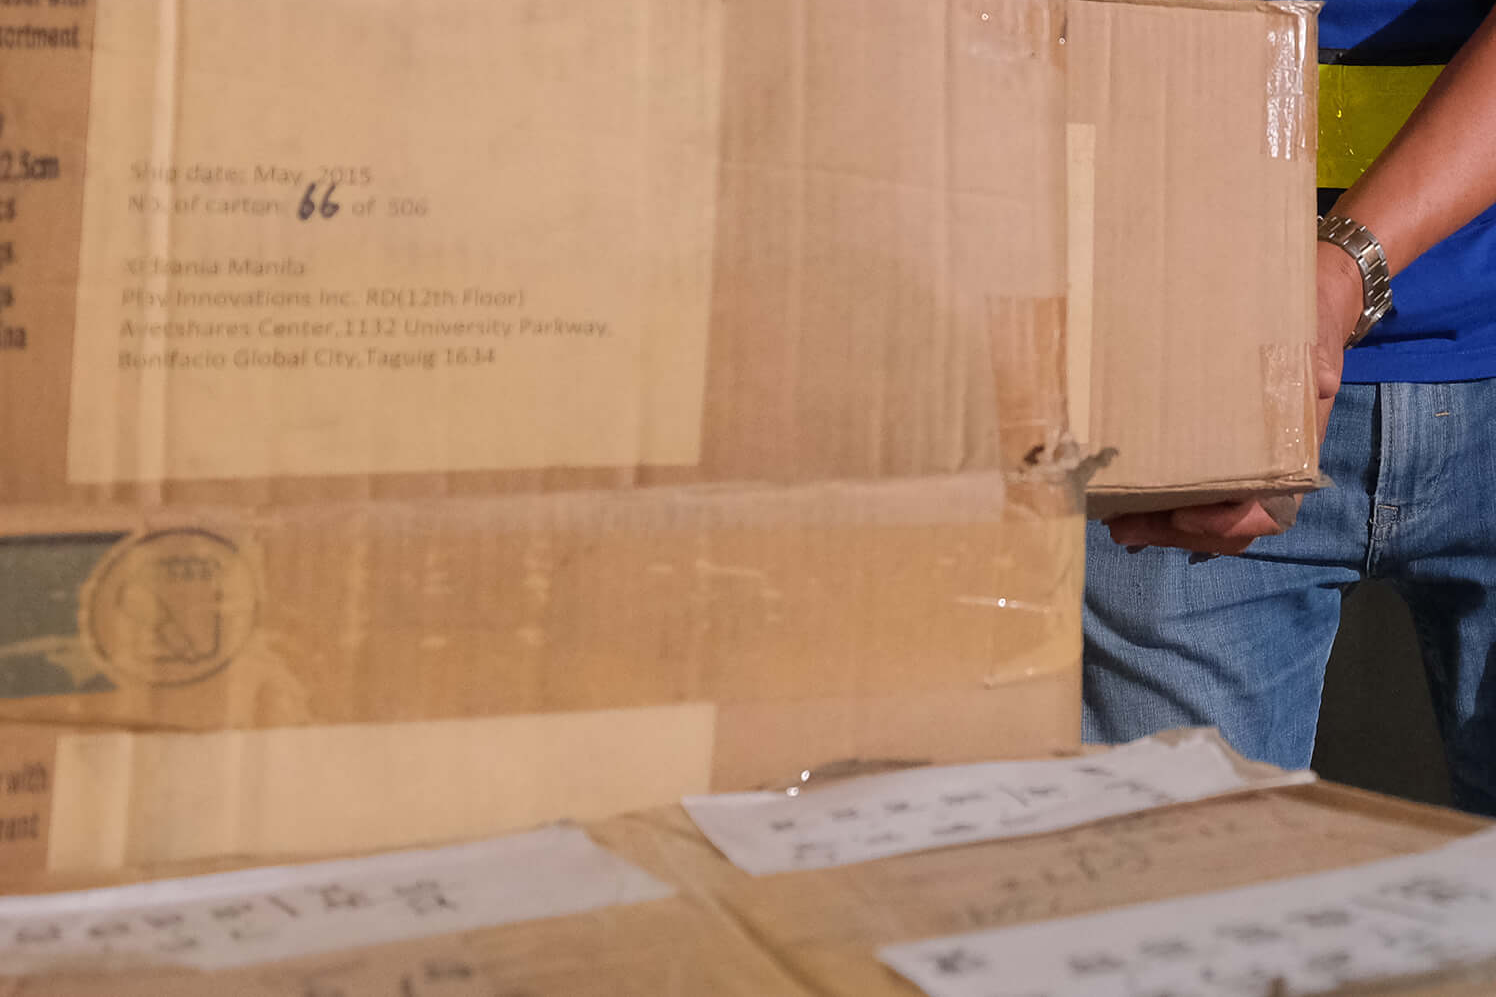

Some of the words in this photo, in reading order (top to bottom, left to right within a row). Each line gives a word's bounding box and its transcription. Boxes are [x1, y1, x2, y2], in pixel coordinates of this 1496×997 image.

[0, 23, 80, 50] ortment
[296, 182, 340, 220] 66
[226, 255, 306, 278] Manila
[176, 287, 309, 308] Innovations
[460, 286, 525, 310] Floor)
[402, 318, 511, 342] University
[231, 347, 304, 370] Global
